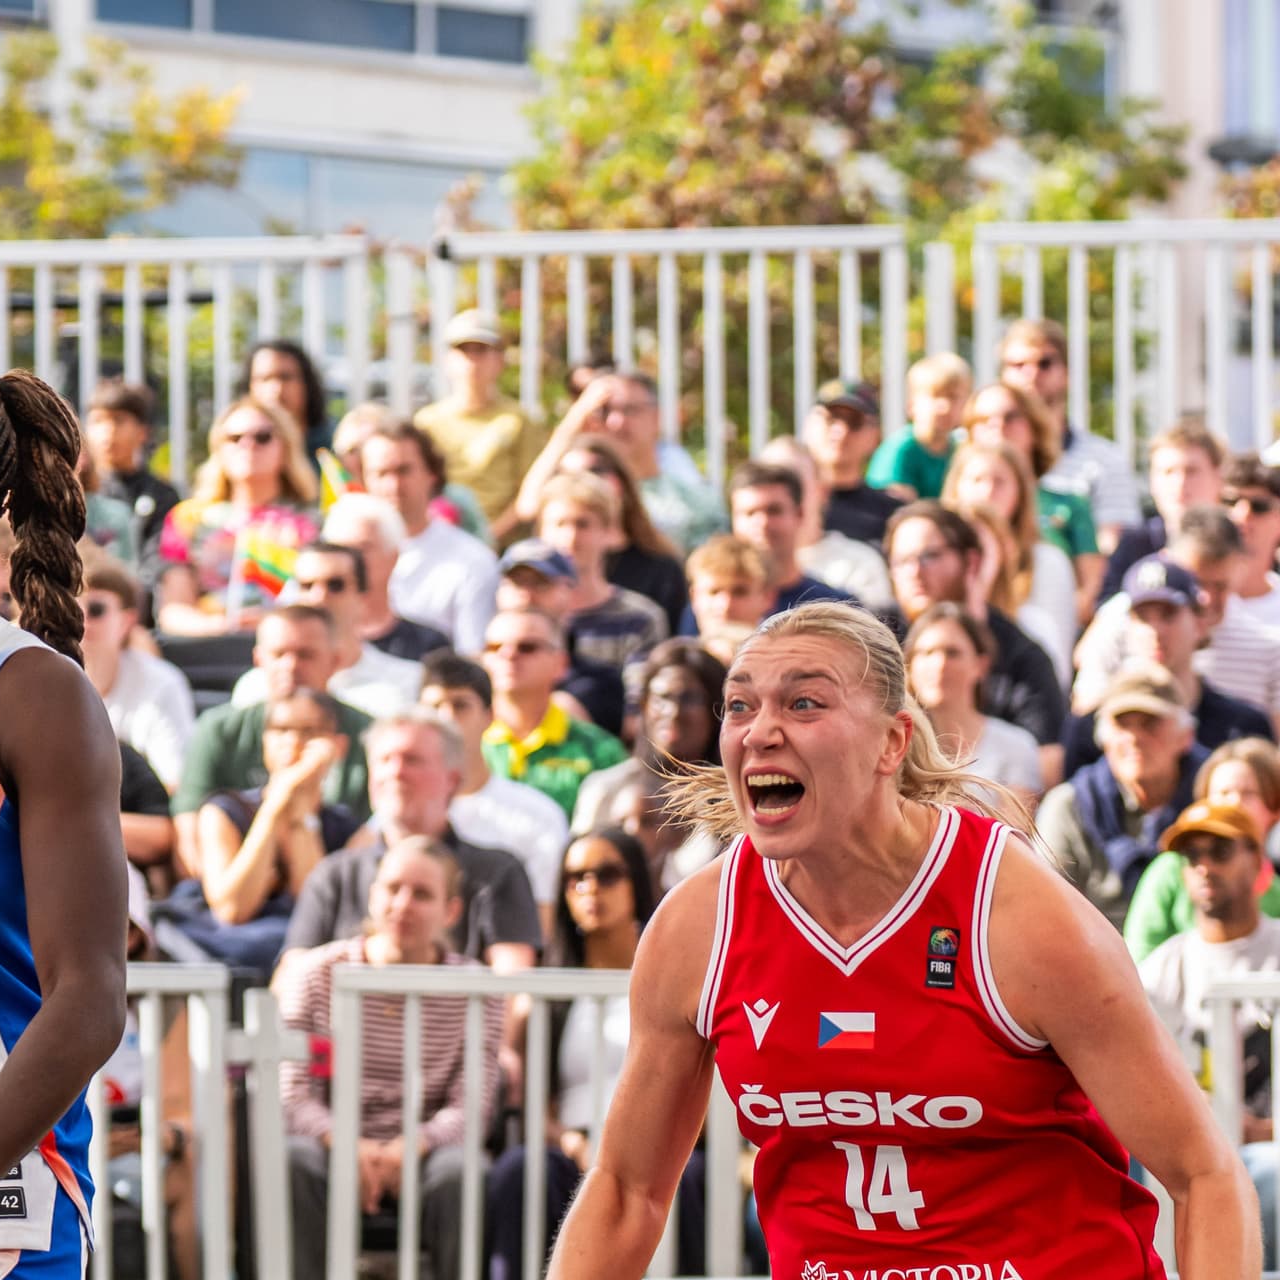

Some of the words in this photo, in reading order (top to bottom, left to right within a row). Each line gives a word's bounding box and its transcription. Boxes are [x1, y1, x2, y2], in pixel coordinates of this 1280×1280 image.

[930, 961, 951, 973] FIBA
[738, 1083, 984, 1129] ČESKO
[833, 1141, 926, 1231] 14
[0, 1195, 20, 1209] 42
